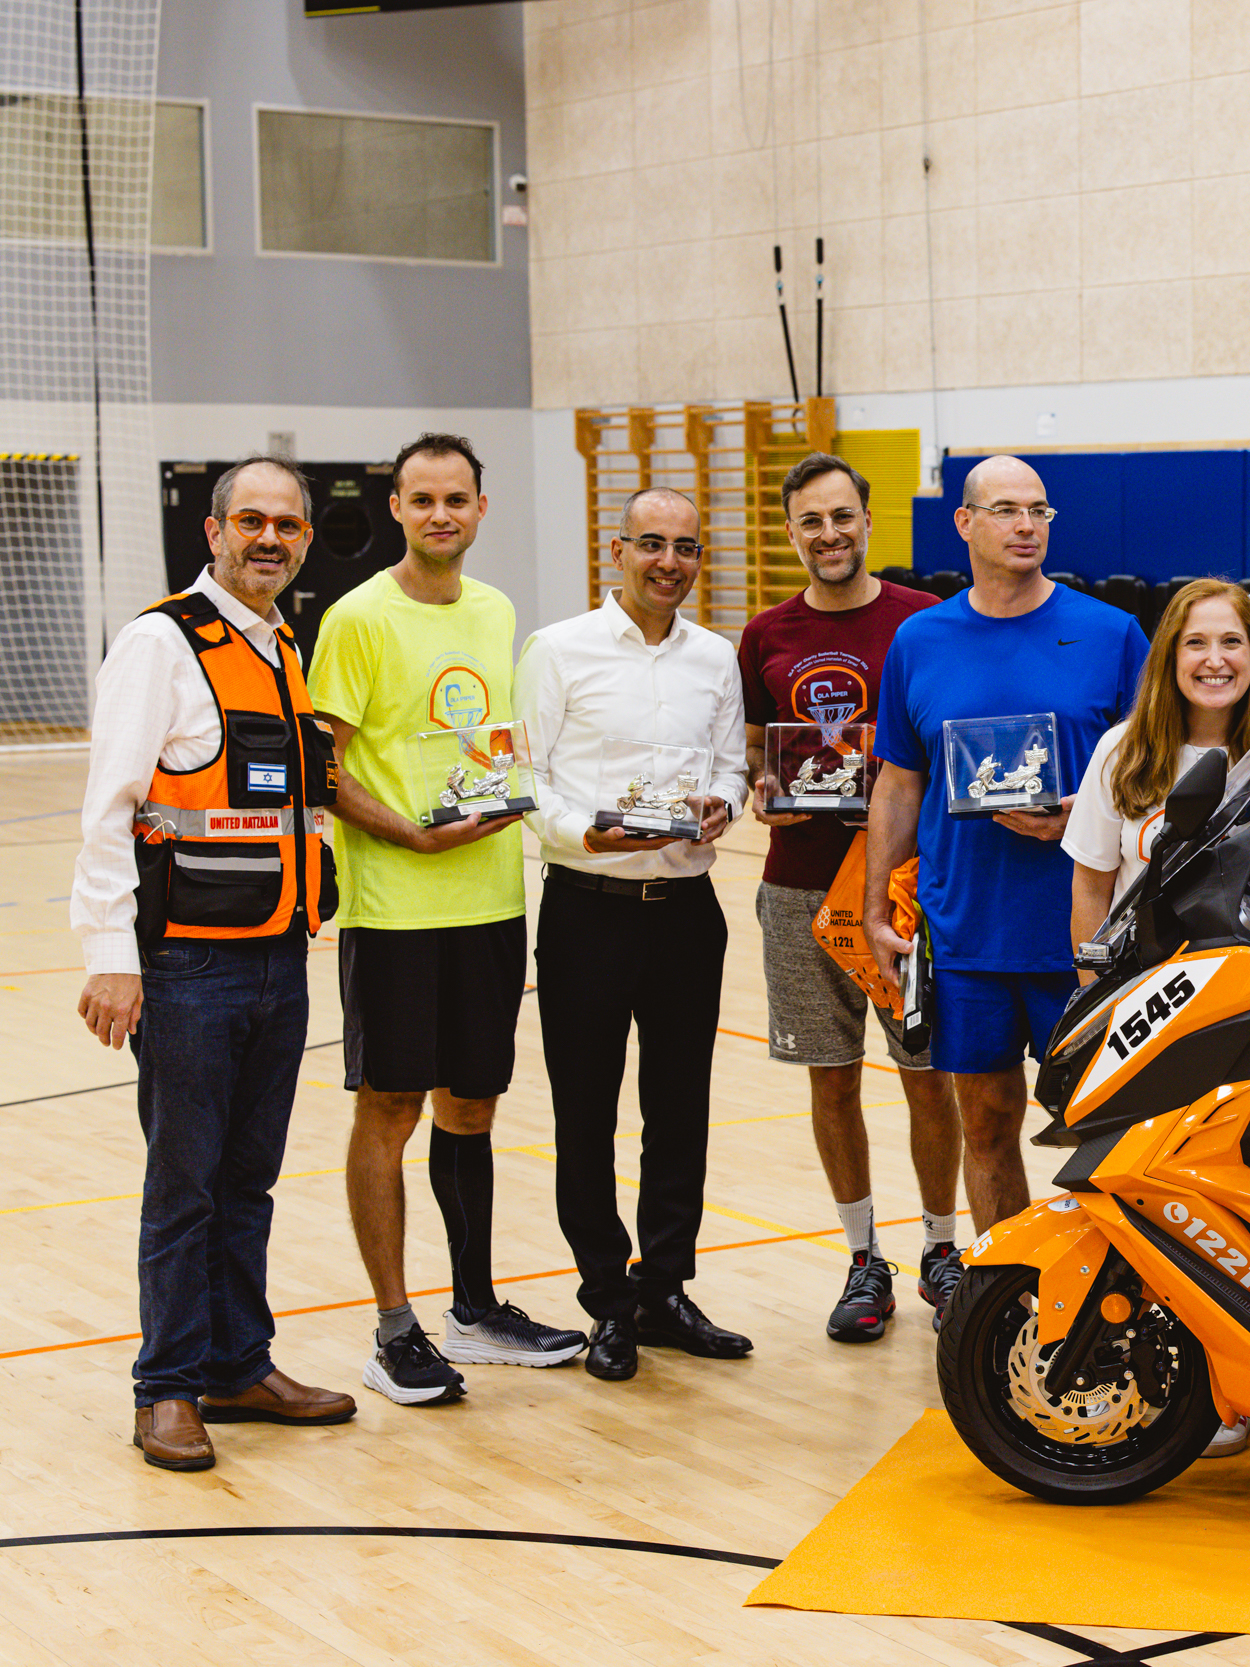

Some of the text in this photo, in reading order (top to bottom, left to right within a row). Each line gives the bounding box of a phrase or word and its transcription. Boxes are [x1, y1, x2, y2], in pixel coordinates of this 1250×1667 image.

[209, 815, 279, 830] UNITED HATZALAH
[831, 909, 854, 919] UNITED
[833, 936, 854, 948] 1221
[1107, 970, 1196, 1061] 1545
